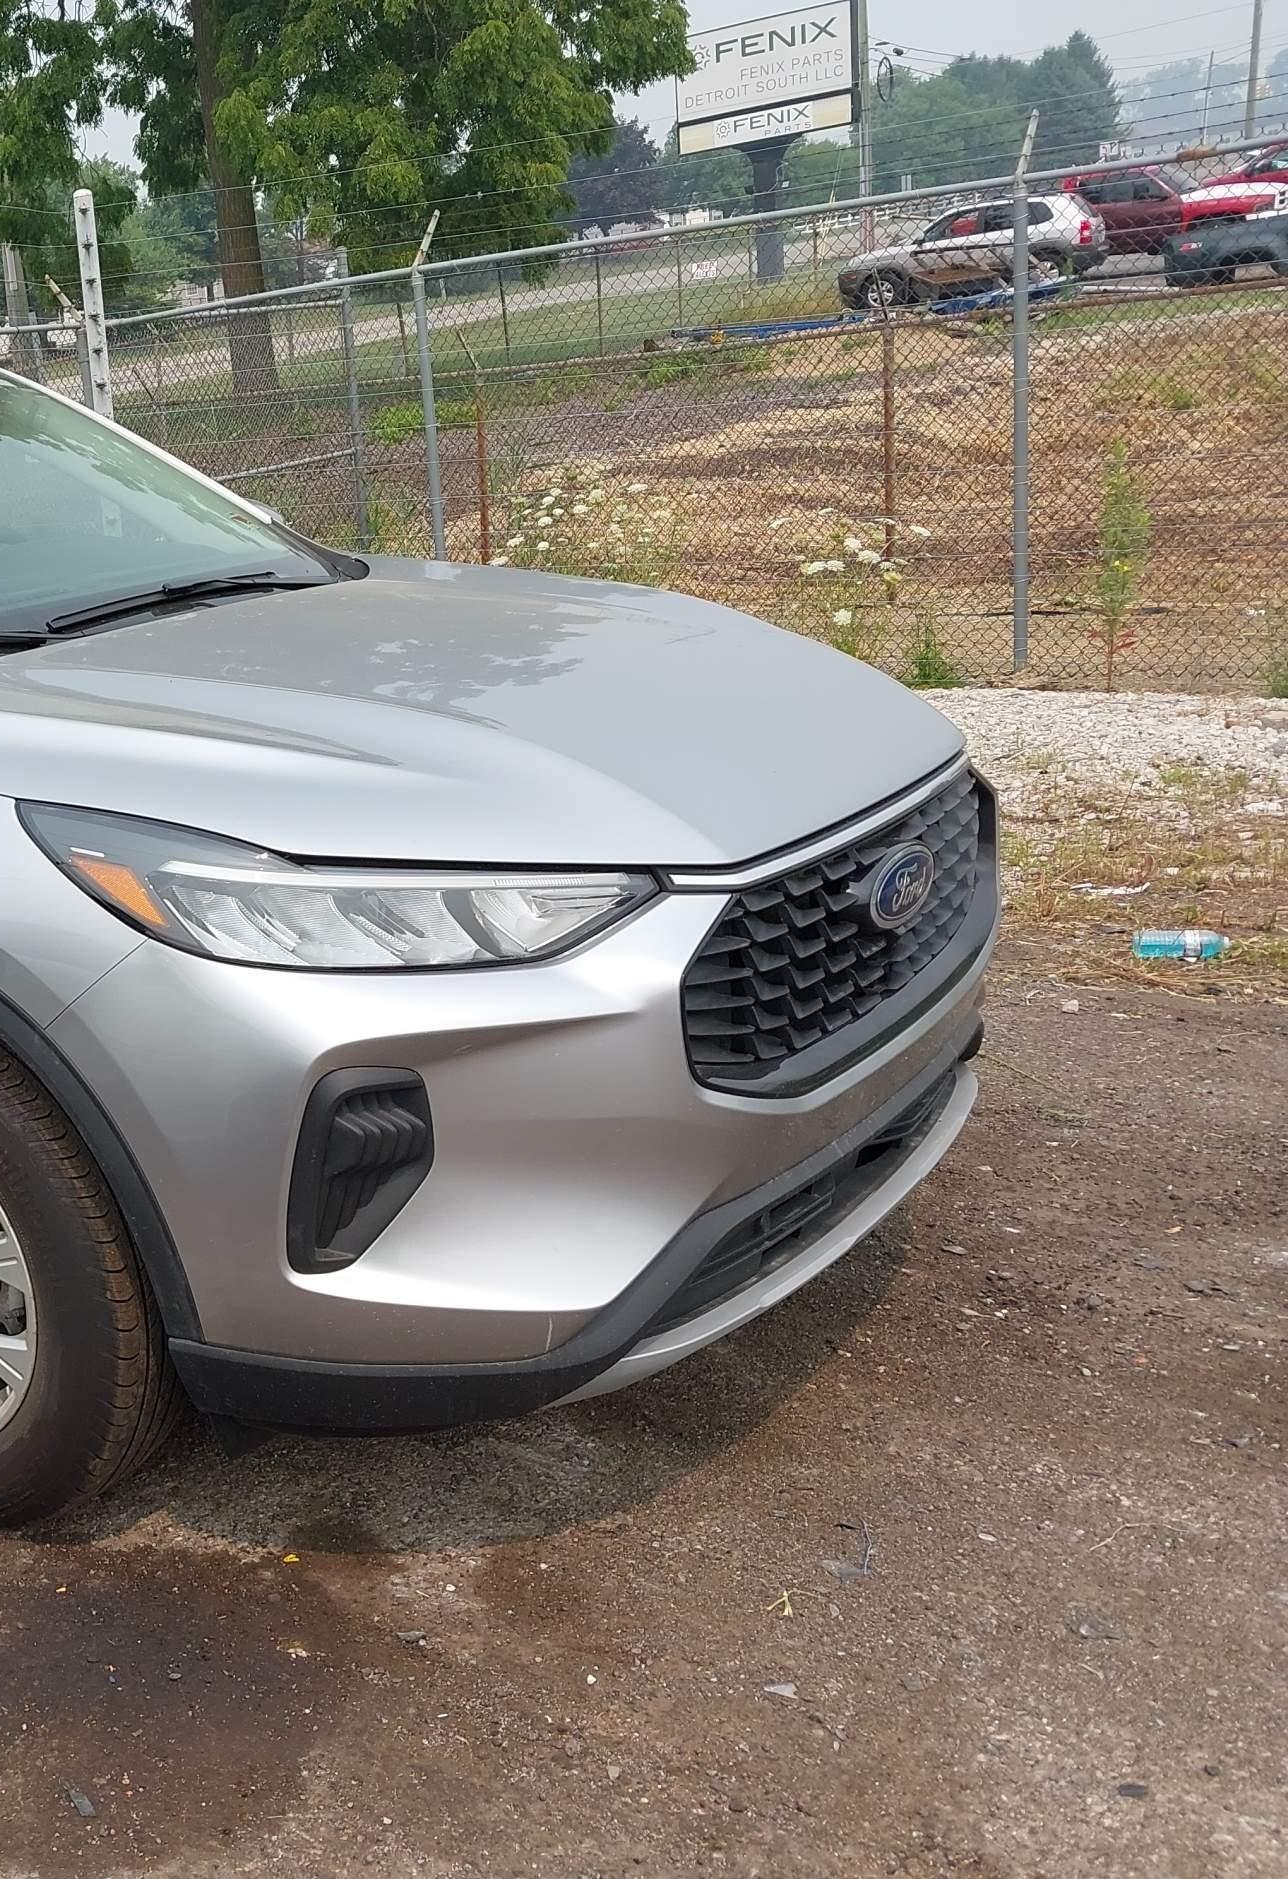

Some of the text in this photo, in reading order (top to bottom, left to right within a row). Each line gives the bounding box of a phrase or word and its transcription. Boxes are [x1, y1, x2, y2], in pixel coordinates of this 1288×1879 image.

[715, 16, 837, 63] FENIX
[740, 48, 844, 81] FENIX PARTS
[685, 64, 844, 109] DETROIT SOUTH LLC
[733, 104, 810, 133] FENIX
[764, 121, 812, 136] PARTS
[893, 862, 926, 912] Ford
